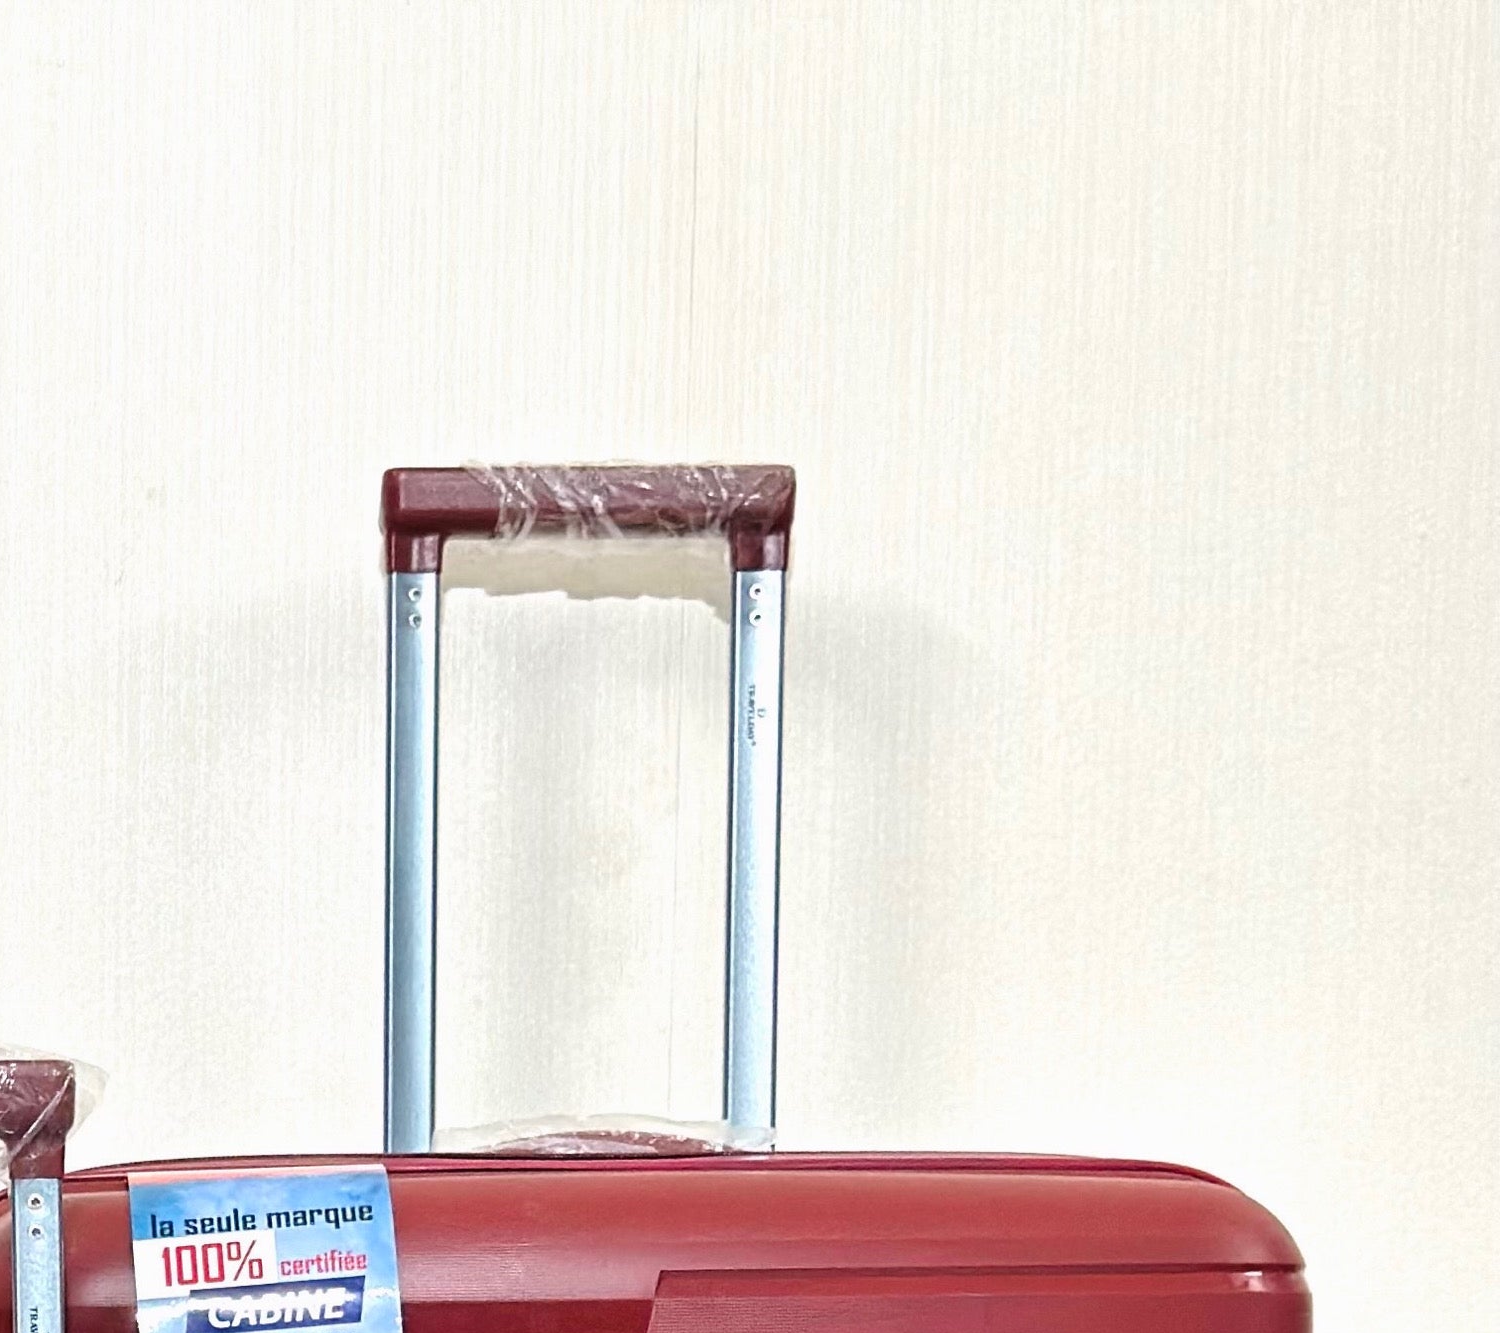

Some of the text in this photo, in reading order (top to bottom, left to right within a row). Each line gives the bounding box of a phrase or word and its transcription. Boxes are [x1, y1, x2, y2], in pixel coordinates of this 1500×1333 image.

[151, 1204, 373, 1238] la seule marque
[161, 1239, 368, 1287] 100% certifiée
